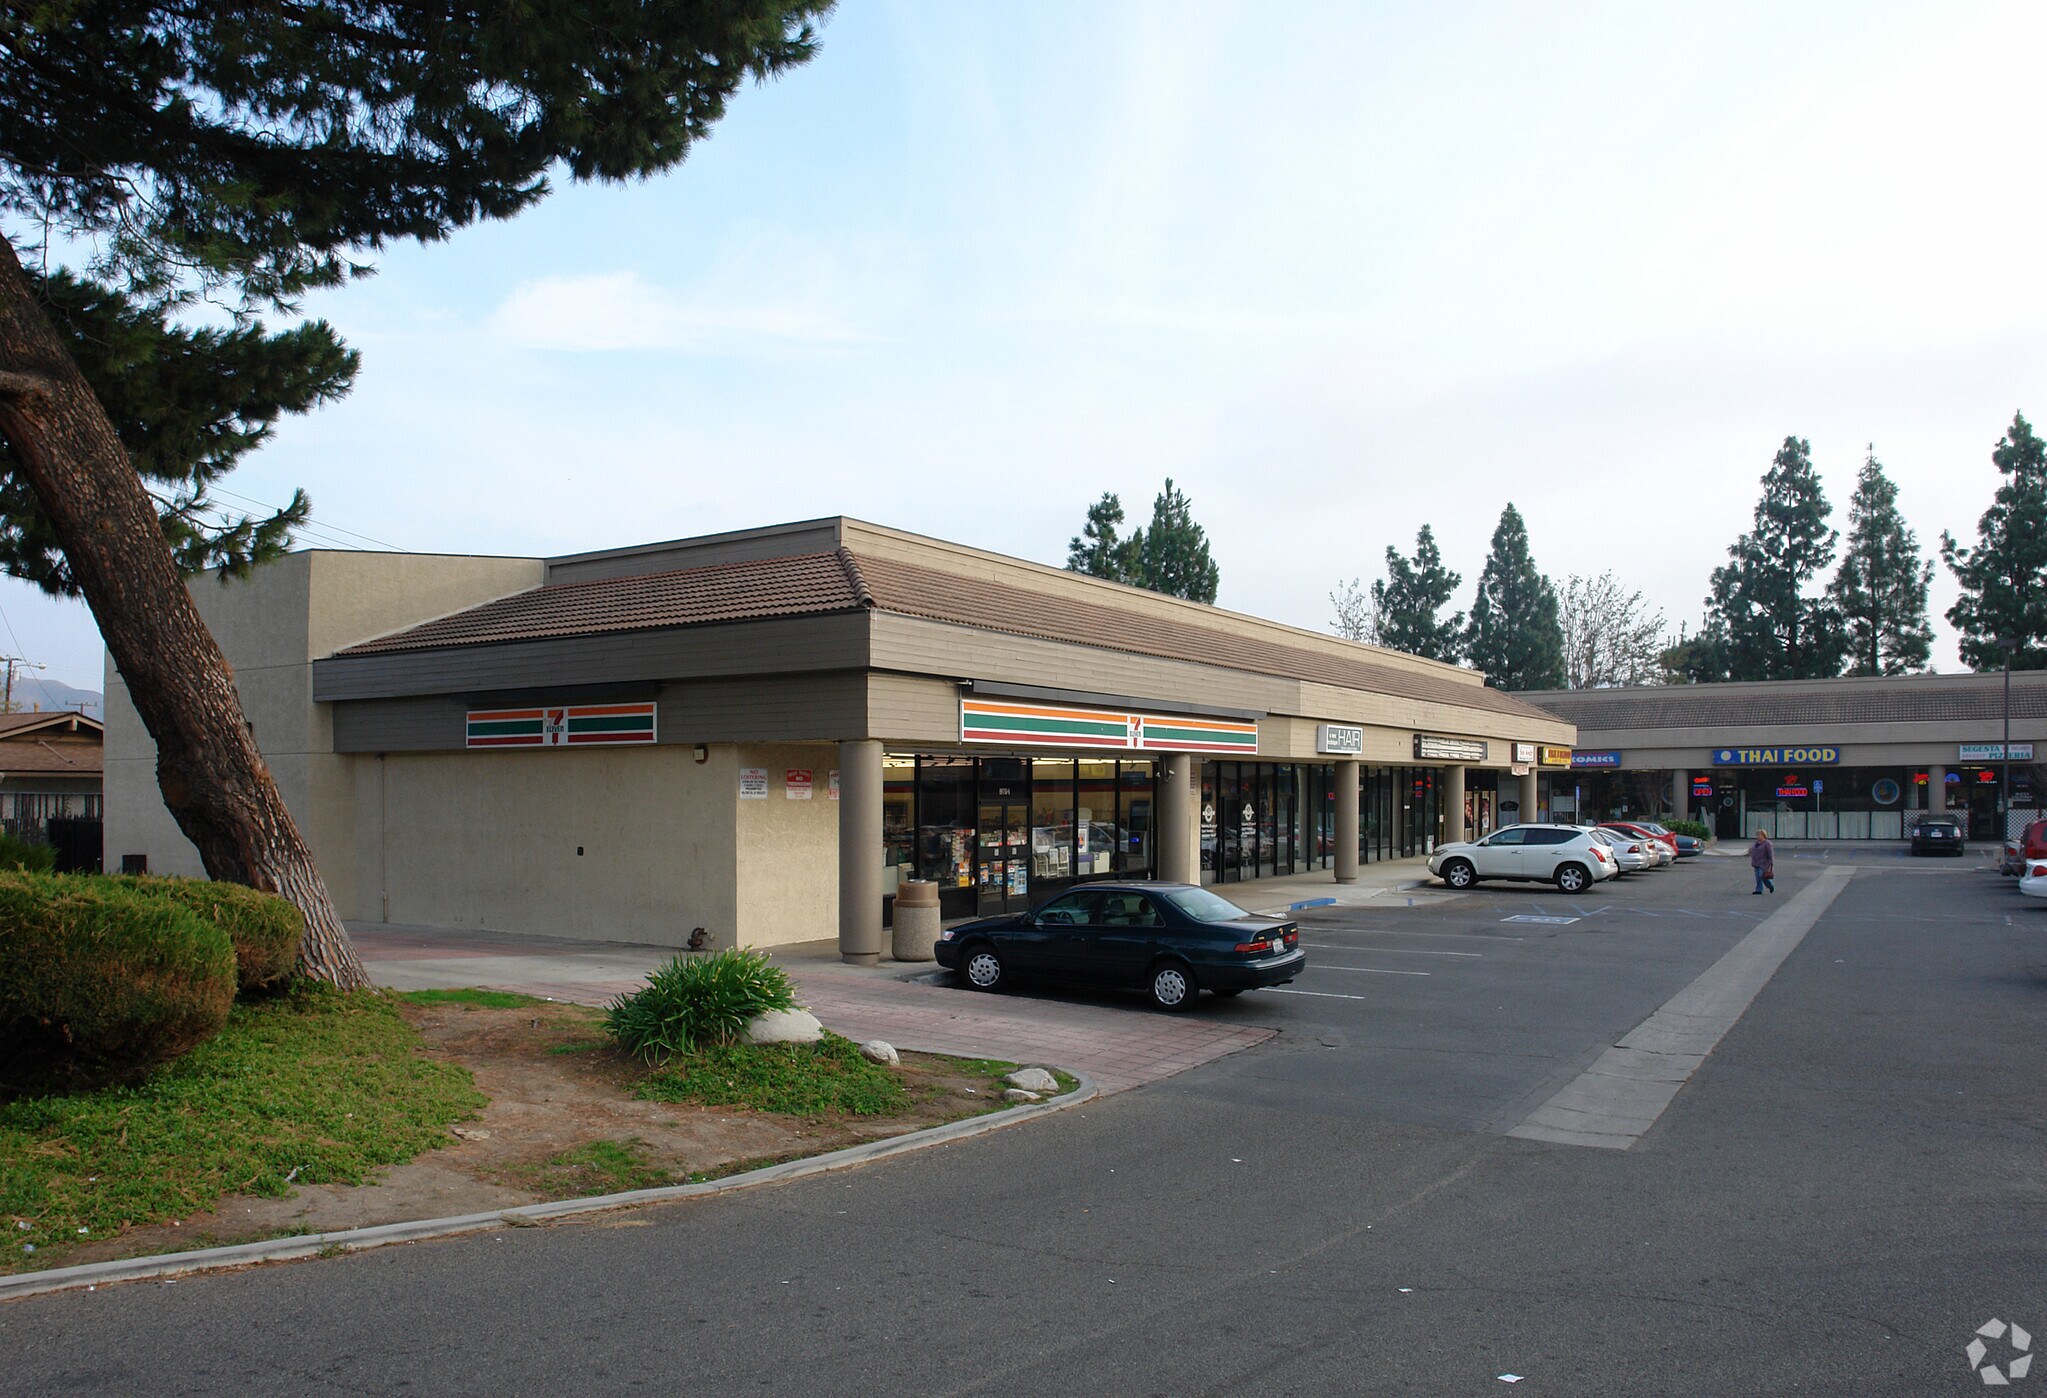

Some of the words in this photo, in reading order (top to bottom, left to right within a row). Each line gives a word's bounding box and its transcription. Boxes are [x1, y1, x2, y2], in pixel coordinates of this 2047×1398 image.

[547, 709, 564, 745] 7
[1338, 729, 1361, 748] HAIR
[1738, 750, 1778, 763] THAI
[1783, 748, 1836, 762] FOOD
[1962, 745, 2000, 753] SEGESTA
